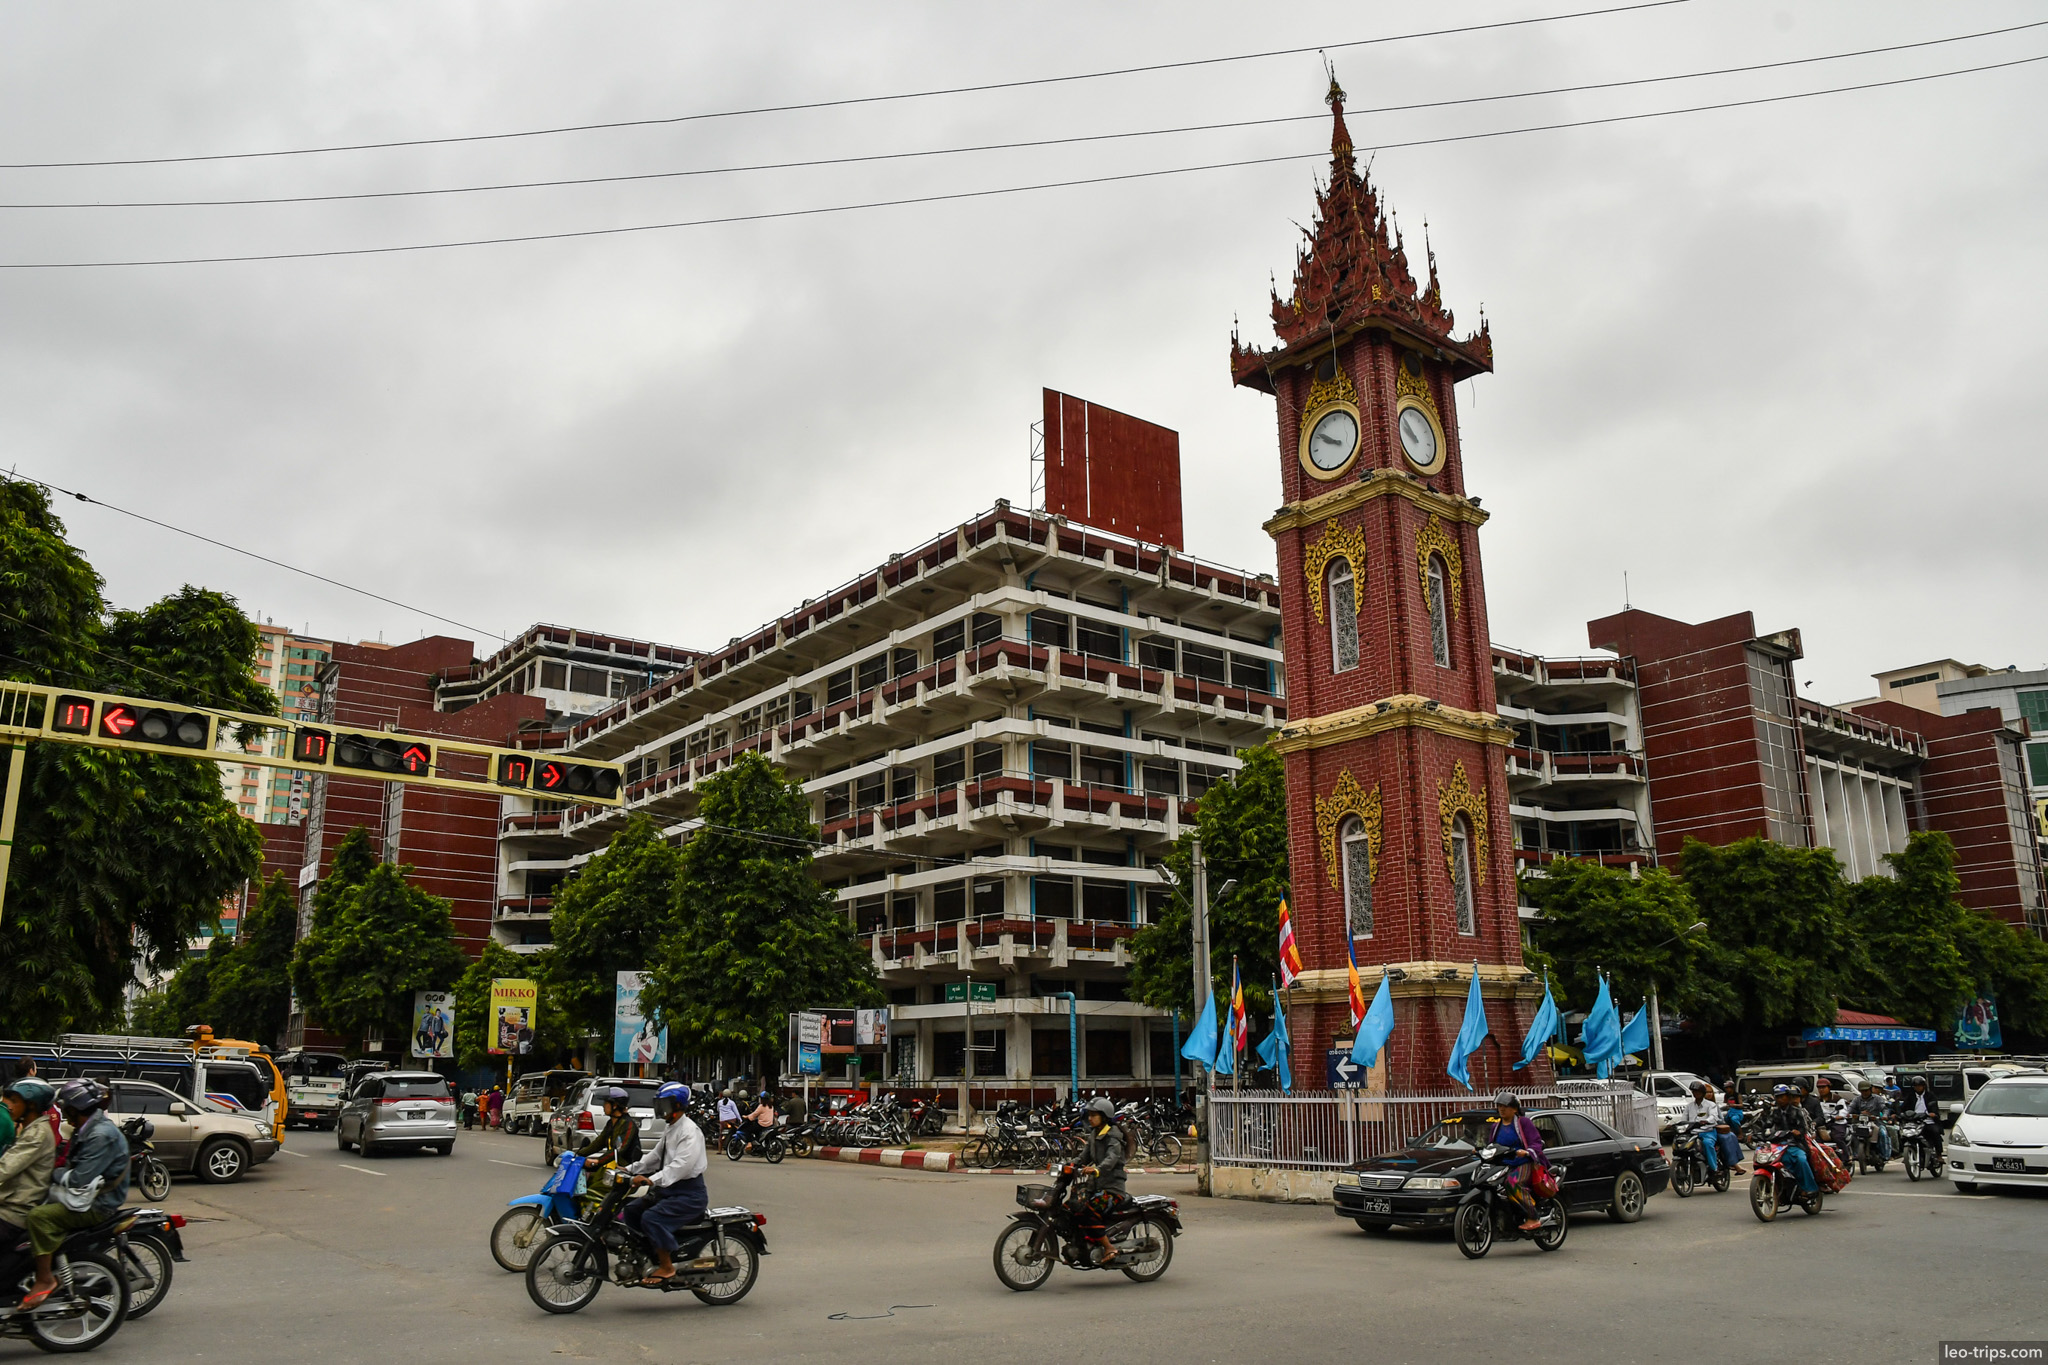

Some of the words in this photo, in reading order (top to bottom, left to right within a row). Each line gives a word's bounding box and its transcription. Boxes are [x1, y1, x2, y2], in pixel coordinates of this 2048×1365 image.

[65, 704, 91, 727] 17
[305, 735, 325, 757] 17
[508, 762, 526, 782] 17
[494, 988, 535, 998] MIKKO
[1333, 1081, 1346, 1089] ONE
[1347, 1081, 1361, 1089] WAY
[1995, 1161, 2024, 1170] 4K-6431
